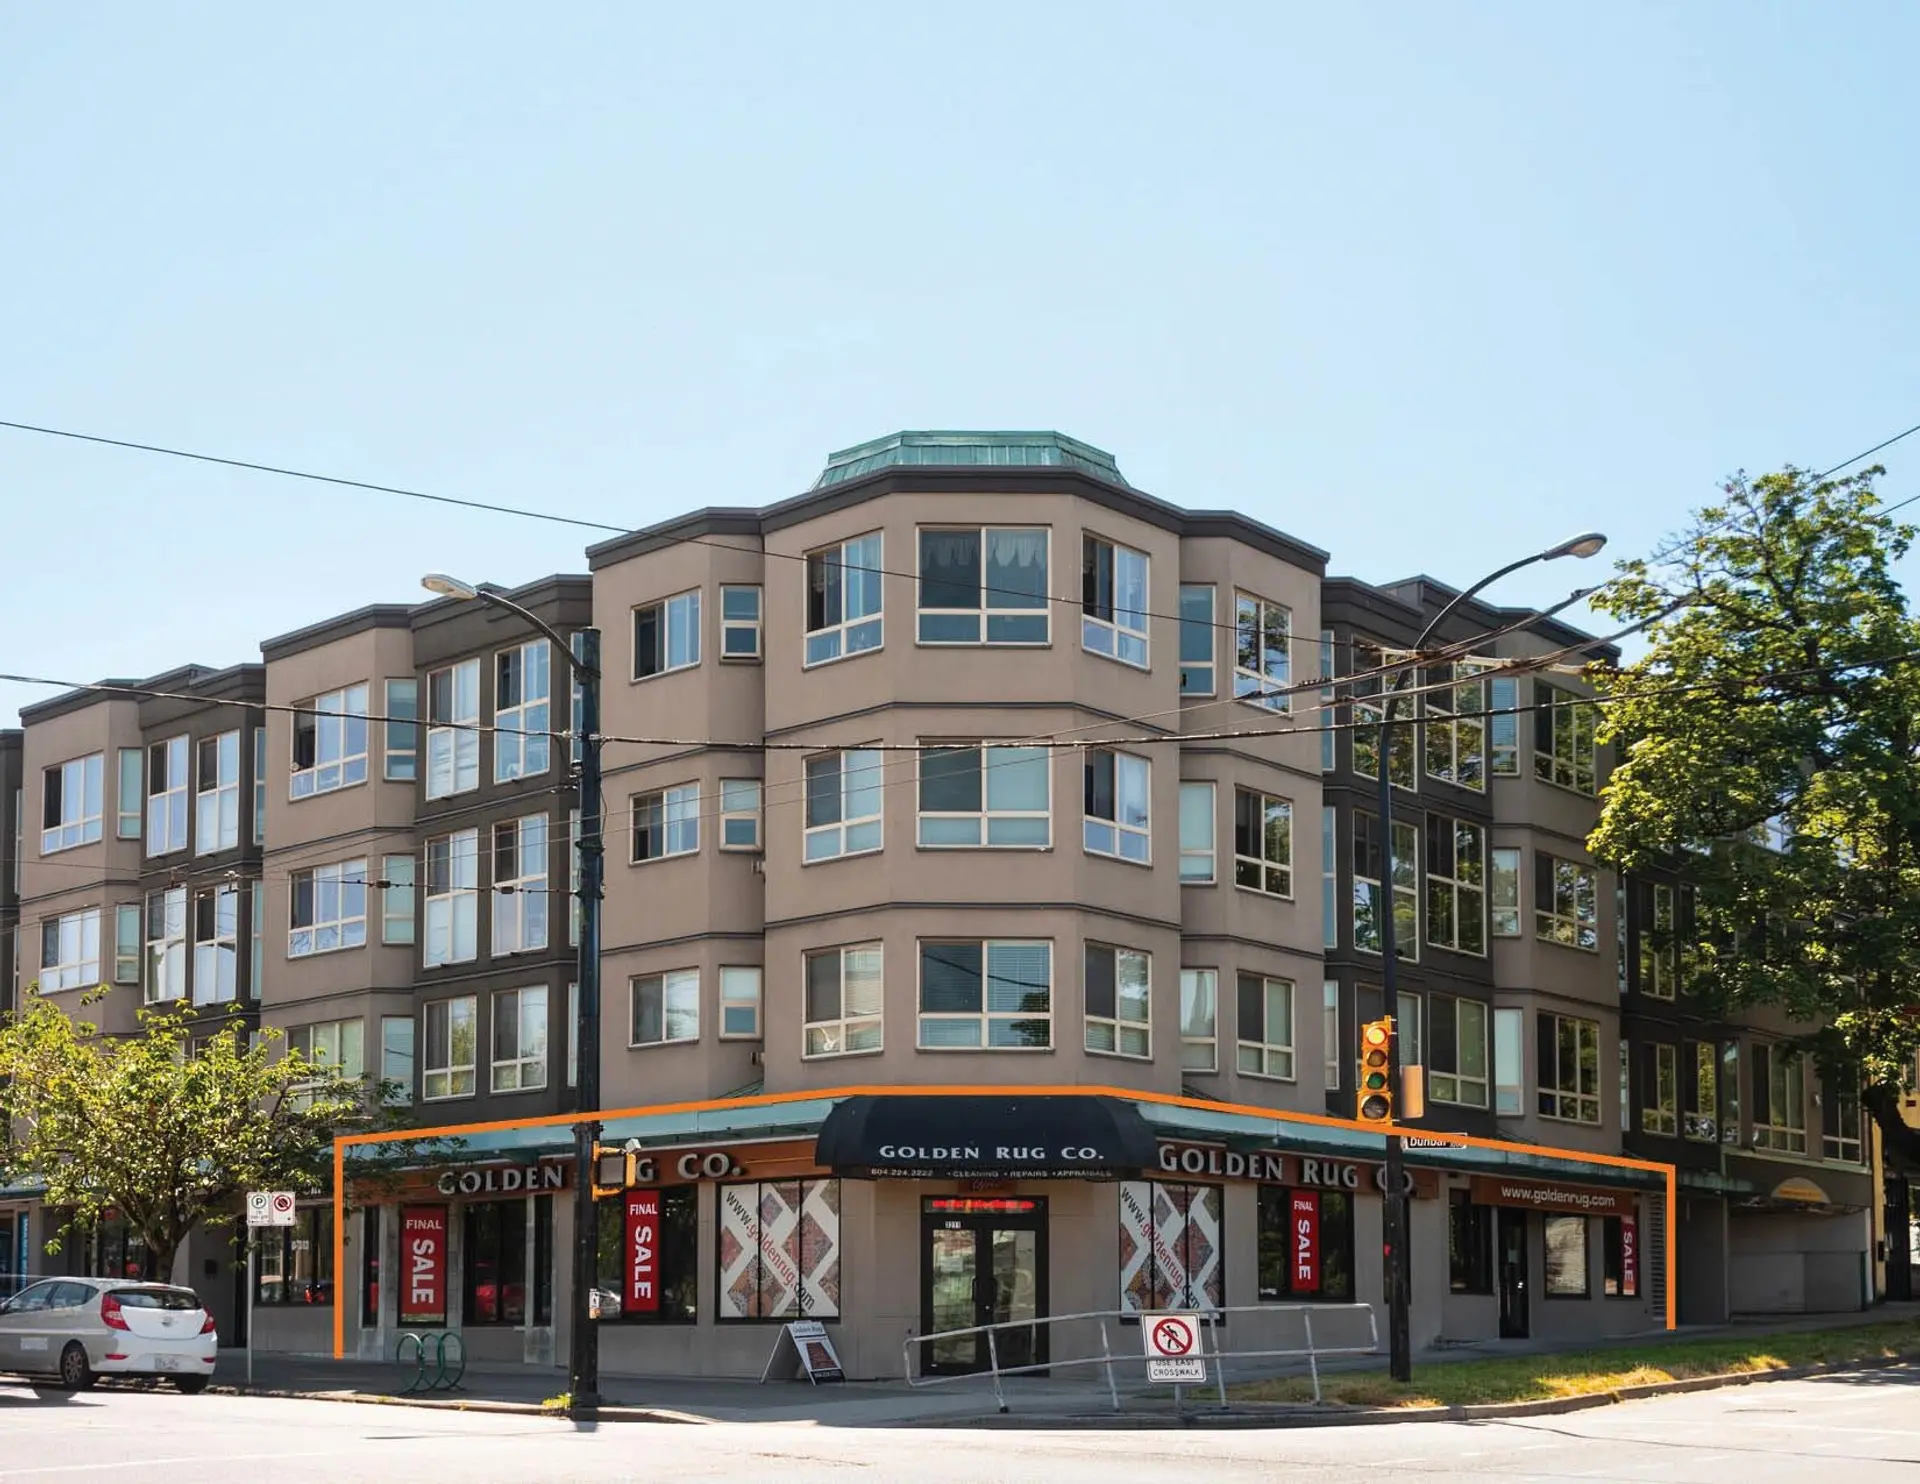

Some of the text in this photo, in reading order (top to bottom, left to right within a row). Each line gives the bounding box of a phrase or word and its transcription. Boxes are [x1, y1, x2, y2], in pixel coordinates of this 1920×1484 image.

[879, 1145, 1104, 1159] GOLDEN RUG CO.
[1410, 1136, 1446, 1147] Dunbar
[677, 1152, 741, 1180] CO.
[953, 1170, 999, 1178] CLEANING
[1159, 1144, 1283, 1180] GOLDEN
[1303, 1158, 1359, 1187] RUG
[437, 1165, 563, 1195] GOLDEN
[1294, 1201, 1314, 1212] FINAL
[1501, 1186, 1615, 1207] www.goldenrug.com
[629, 1203, 658, 1216] FINAL
[406, 1219, 442, 1230] FINAL
[1298, 1218, 1311, 1280] SALE
[1623, 1230, 1634, 1282] SALE
[412, 1238, 435, 1304] SALE
[634, 1225, 652, 1299] SALE
[1153, 1368, 1200, 1377] CROSSWALK
